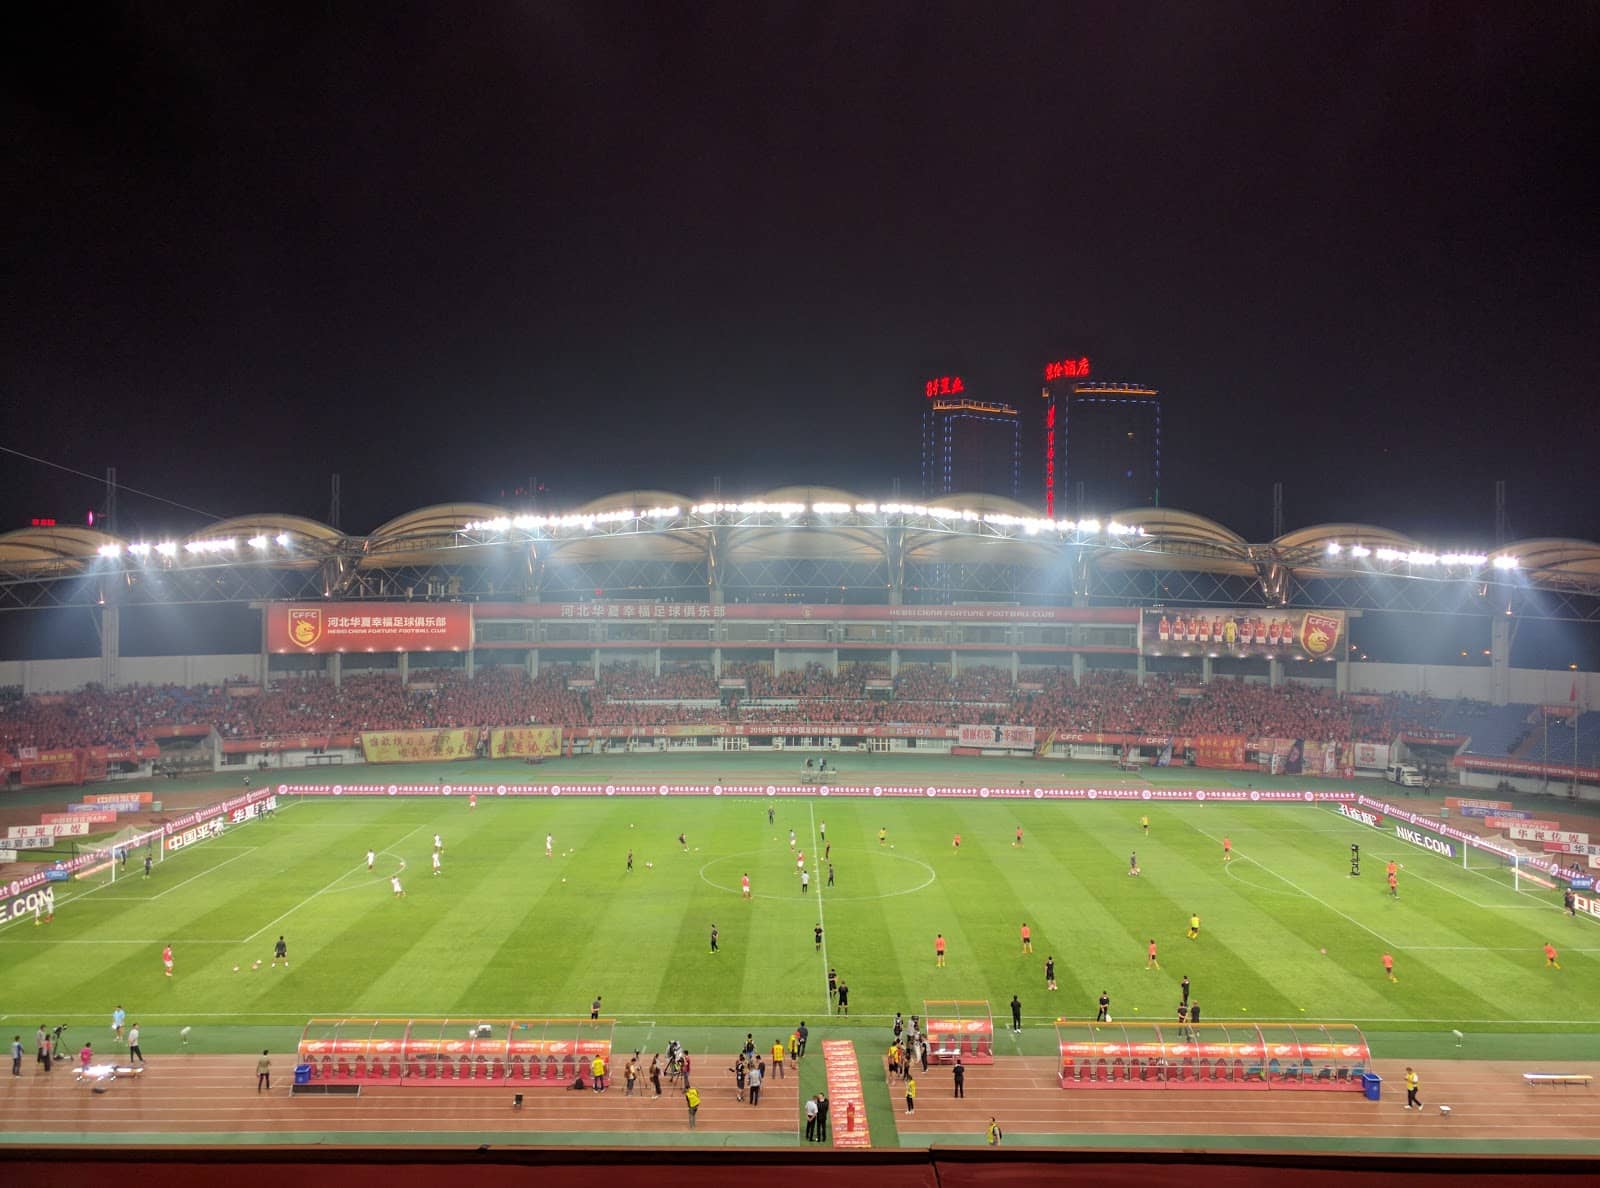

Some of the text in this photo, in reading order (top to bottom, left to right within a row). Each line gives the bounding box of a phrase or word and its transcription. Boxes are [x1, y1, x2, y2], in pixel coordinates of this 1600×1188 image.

[561, 604, 727, 618] 河北华夏幸福足球俱乐部
[327, 616, 447, 628] 河北华夏幸福足球俱乐部
[1308, 616, 1337, 629] CFFC
[1395, 825, 1452, 858] NIKE.COM
